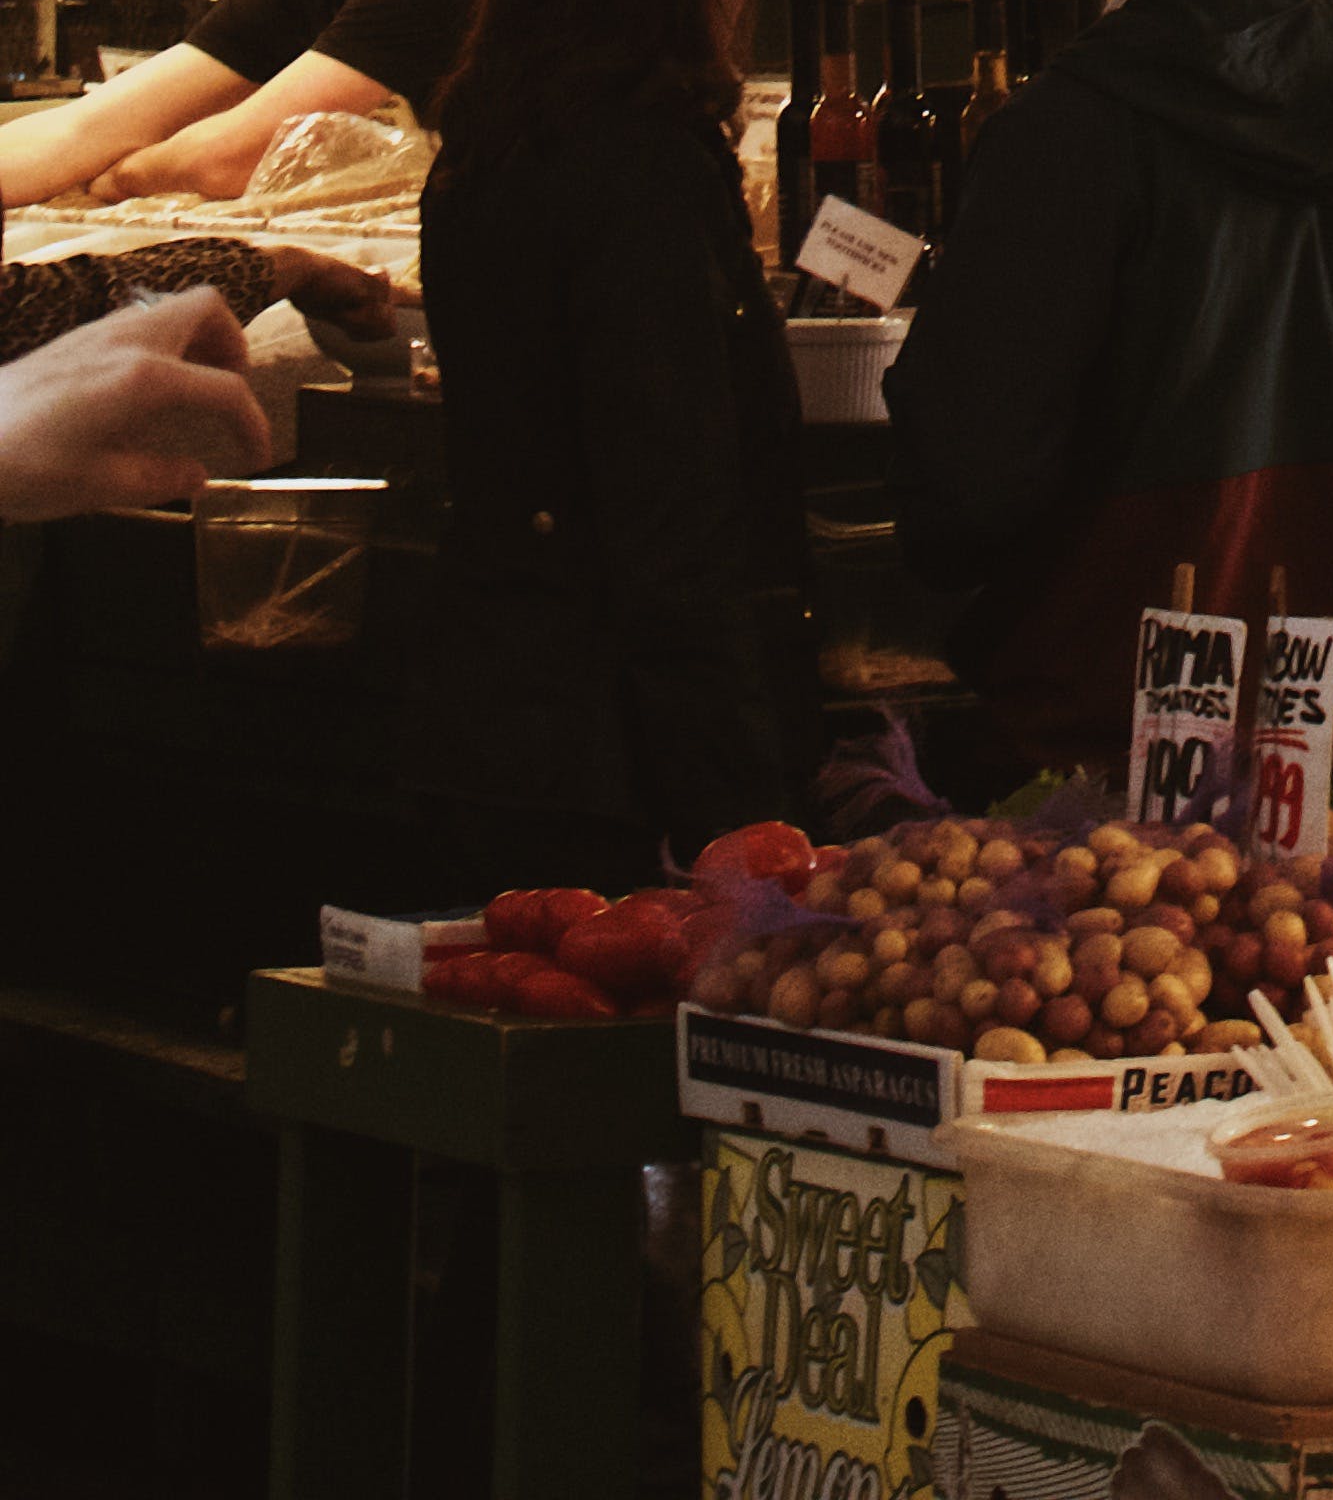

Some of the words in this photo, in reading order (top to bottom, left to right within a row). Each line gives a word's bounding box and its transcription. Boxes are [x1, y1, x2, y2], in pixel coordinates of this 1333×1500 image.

[770, 1050, 827, 1086] FRESH
[750, 1147, 916, 1306] Sweet
[761, 1269, 880, 1425] Deal
